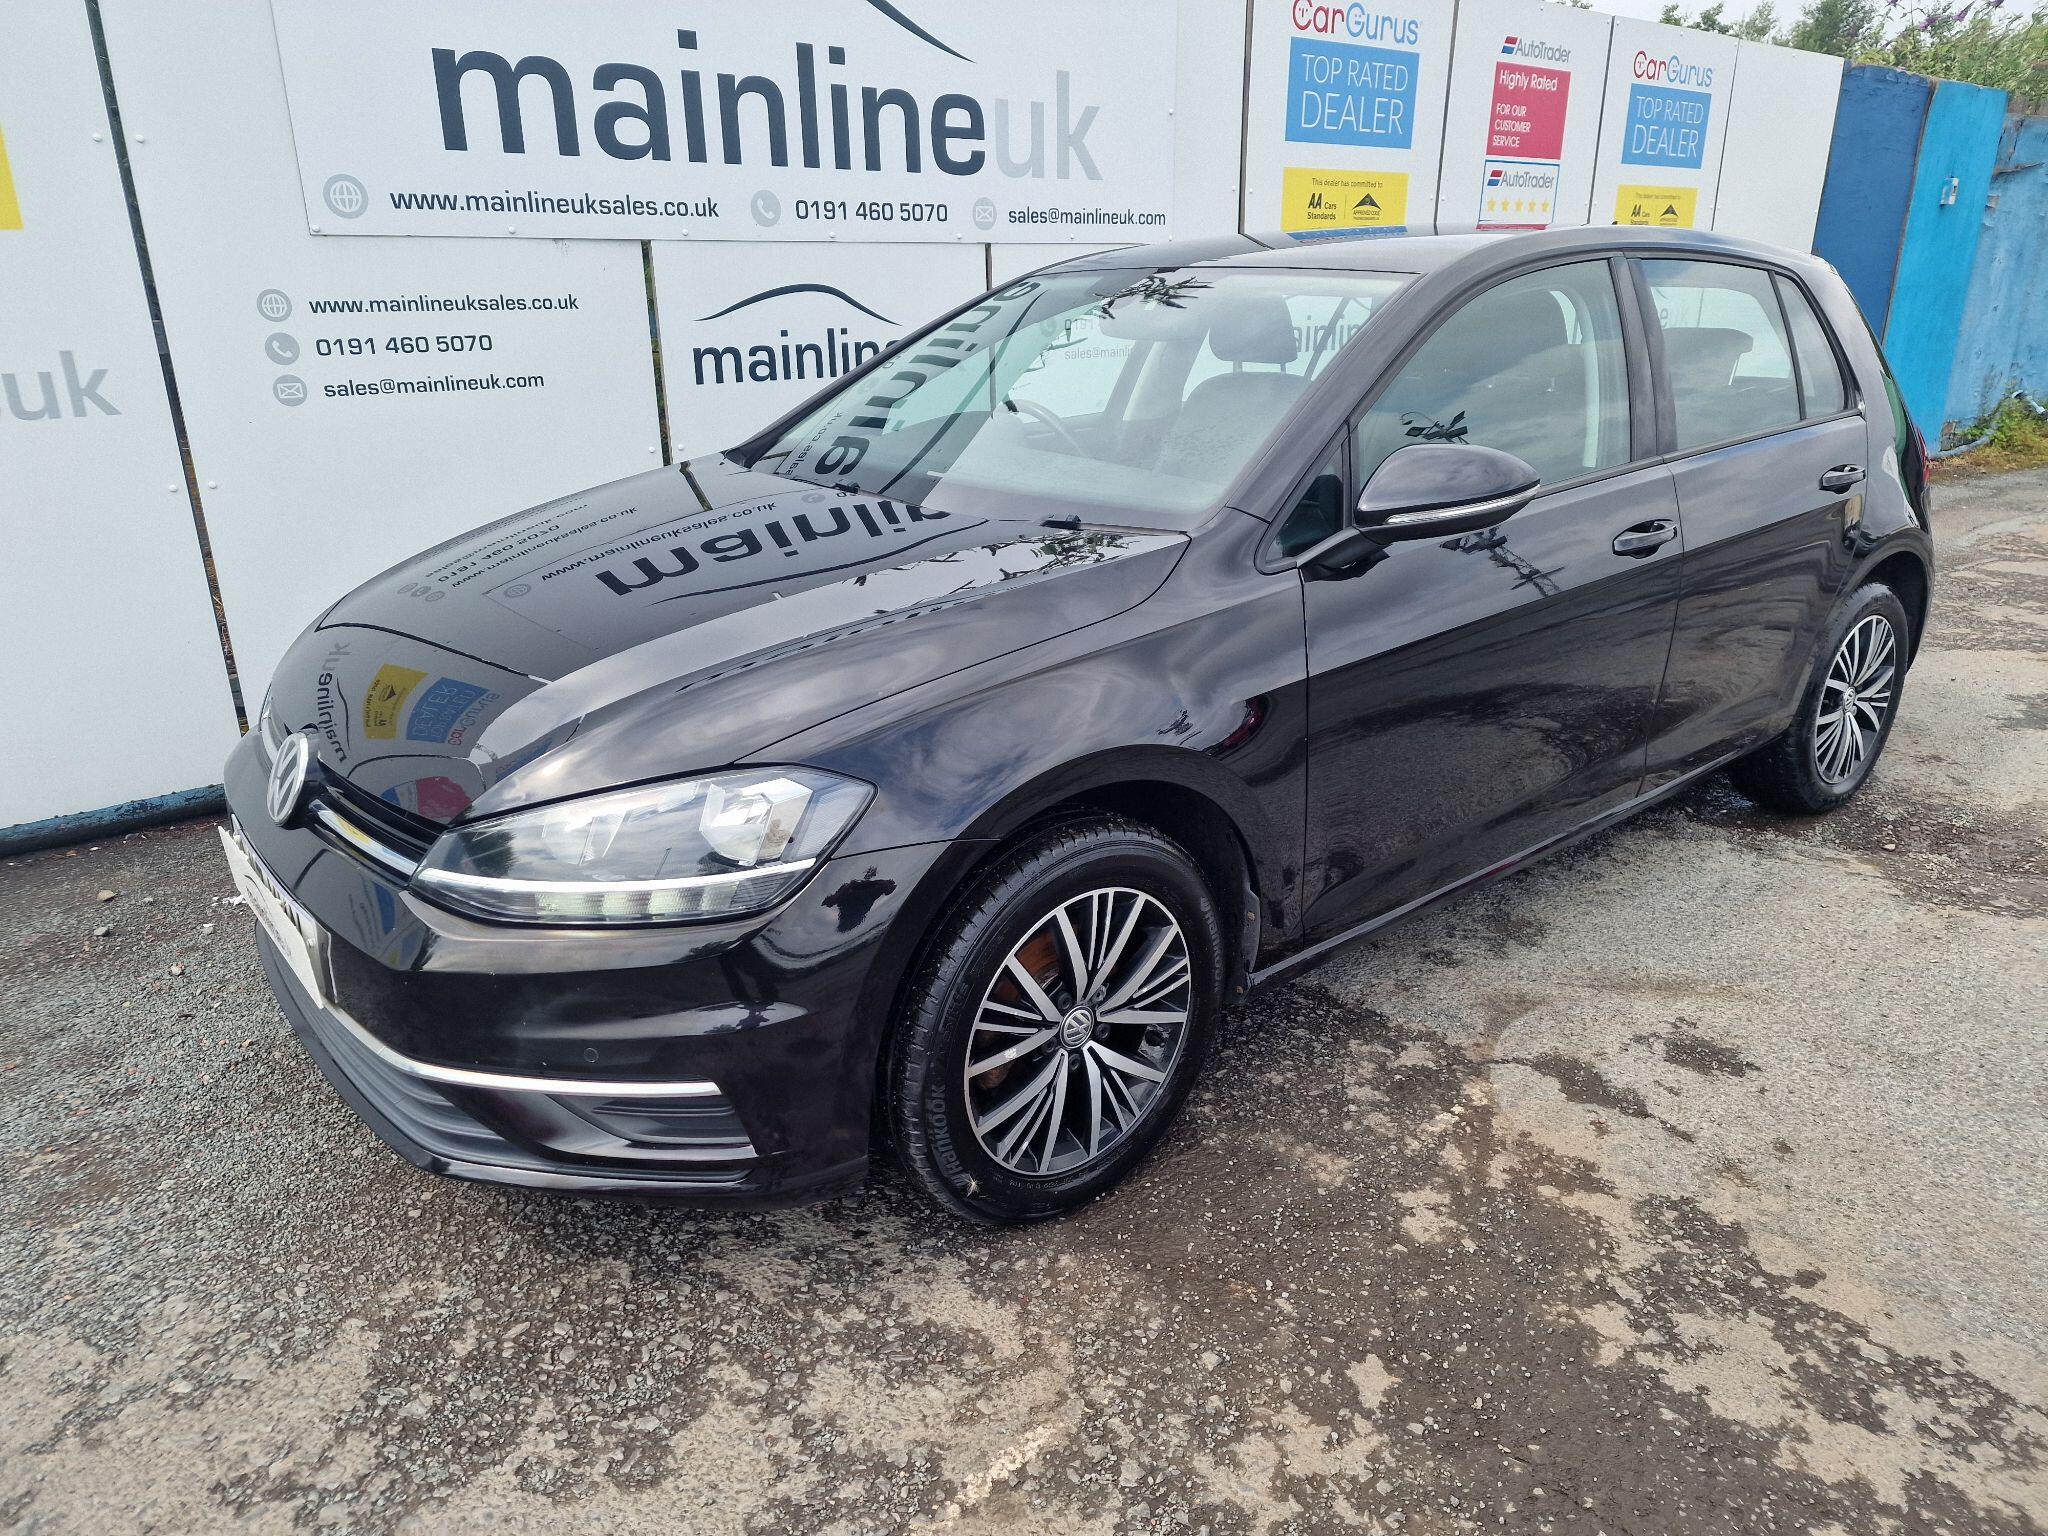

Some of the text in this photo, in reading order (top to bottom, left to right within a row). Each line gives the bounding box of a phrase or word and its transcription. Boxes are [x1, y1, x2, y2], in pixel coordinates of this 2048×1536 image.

[1293, 0, 1418, 45] CarGurus
[1515, 37, 1571, 63] AutoTrader
[1302, 53, 1408, 91] TOP RATED
[1633, 50, 1713, 87] CarGurus
[1499, 70, 1558, 92] Highly Rated
[1301, 90, 1403, 134] DEALER
[1496, 104, 1527, 117] FOR OUR
[1636, 96, 1704, 124] TOP RATED
[1494, 119, 1531, 132] CUSTOMER
[1493, 135, 1520, 148] SERVICE
[1631, 124, 1699, 158] DEALER
[1500, 170, 1554, 189] AutoTrader
[389, 189, 719, 218] www.mainlineuksales.co.uk
[795, 200, 948, 222] 0191 460 5070
[1308, 193, 1337, 210] AA Cars
[1008, 206, 1166, 226] sales@mainlineuk.com
[1307, 211, 1336, 220] Standards
[309, 294, 579, 314] www.mainlineuksales.co.uk
[316, 334, 493, 356] 0191 460 5070
[324, 373, 545, 397] sales@mainlineuk.com
